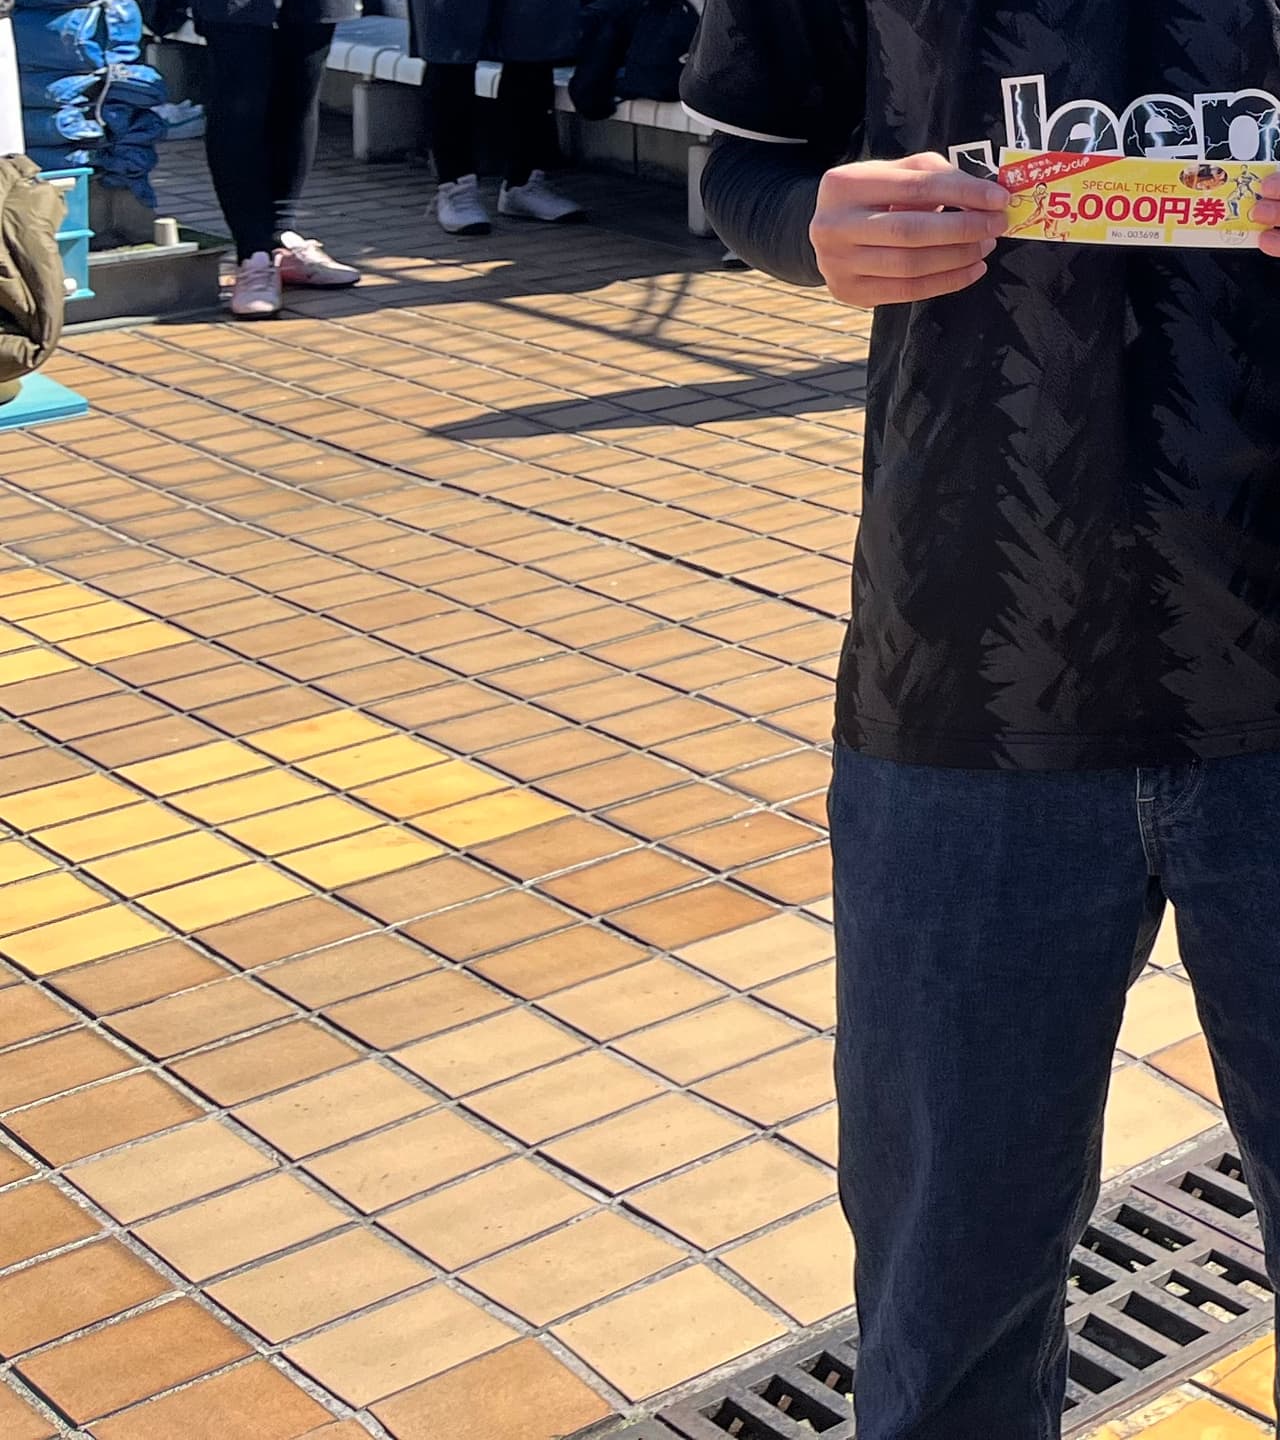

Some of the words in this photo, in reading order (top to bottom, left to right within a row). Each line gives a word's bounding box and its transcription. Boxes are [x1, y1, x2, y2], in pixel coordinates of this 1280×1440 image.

[1082, 180, 1130, 193] SPECIAL
[1136, 183, 1178, 194] TICKET
[1048, 191, 1226, 226] 5,000円券
